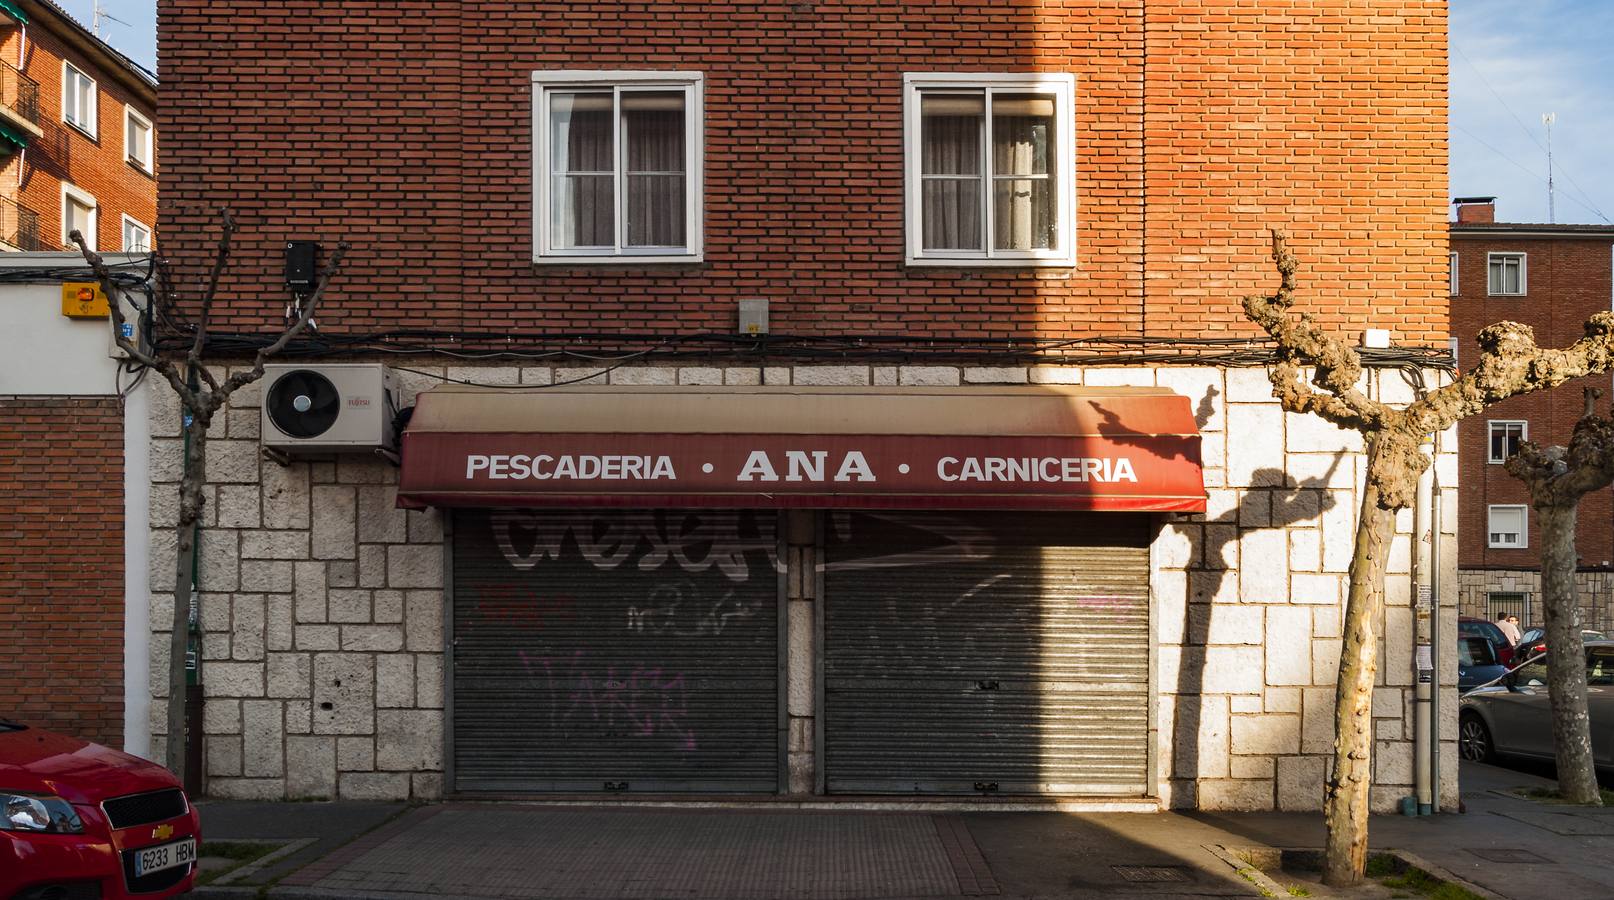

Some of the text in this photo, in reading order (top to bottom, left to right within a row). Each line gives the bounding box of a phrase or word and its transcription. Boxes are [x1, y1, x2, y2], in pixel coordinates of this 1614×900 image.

[466, 450, 1138, 483] PESCADERIA ANA CARNICERIA
[143, 842, 194, 871] 6233 HBM
